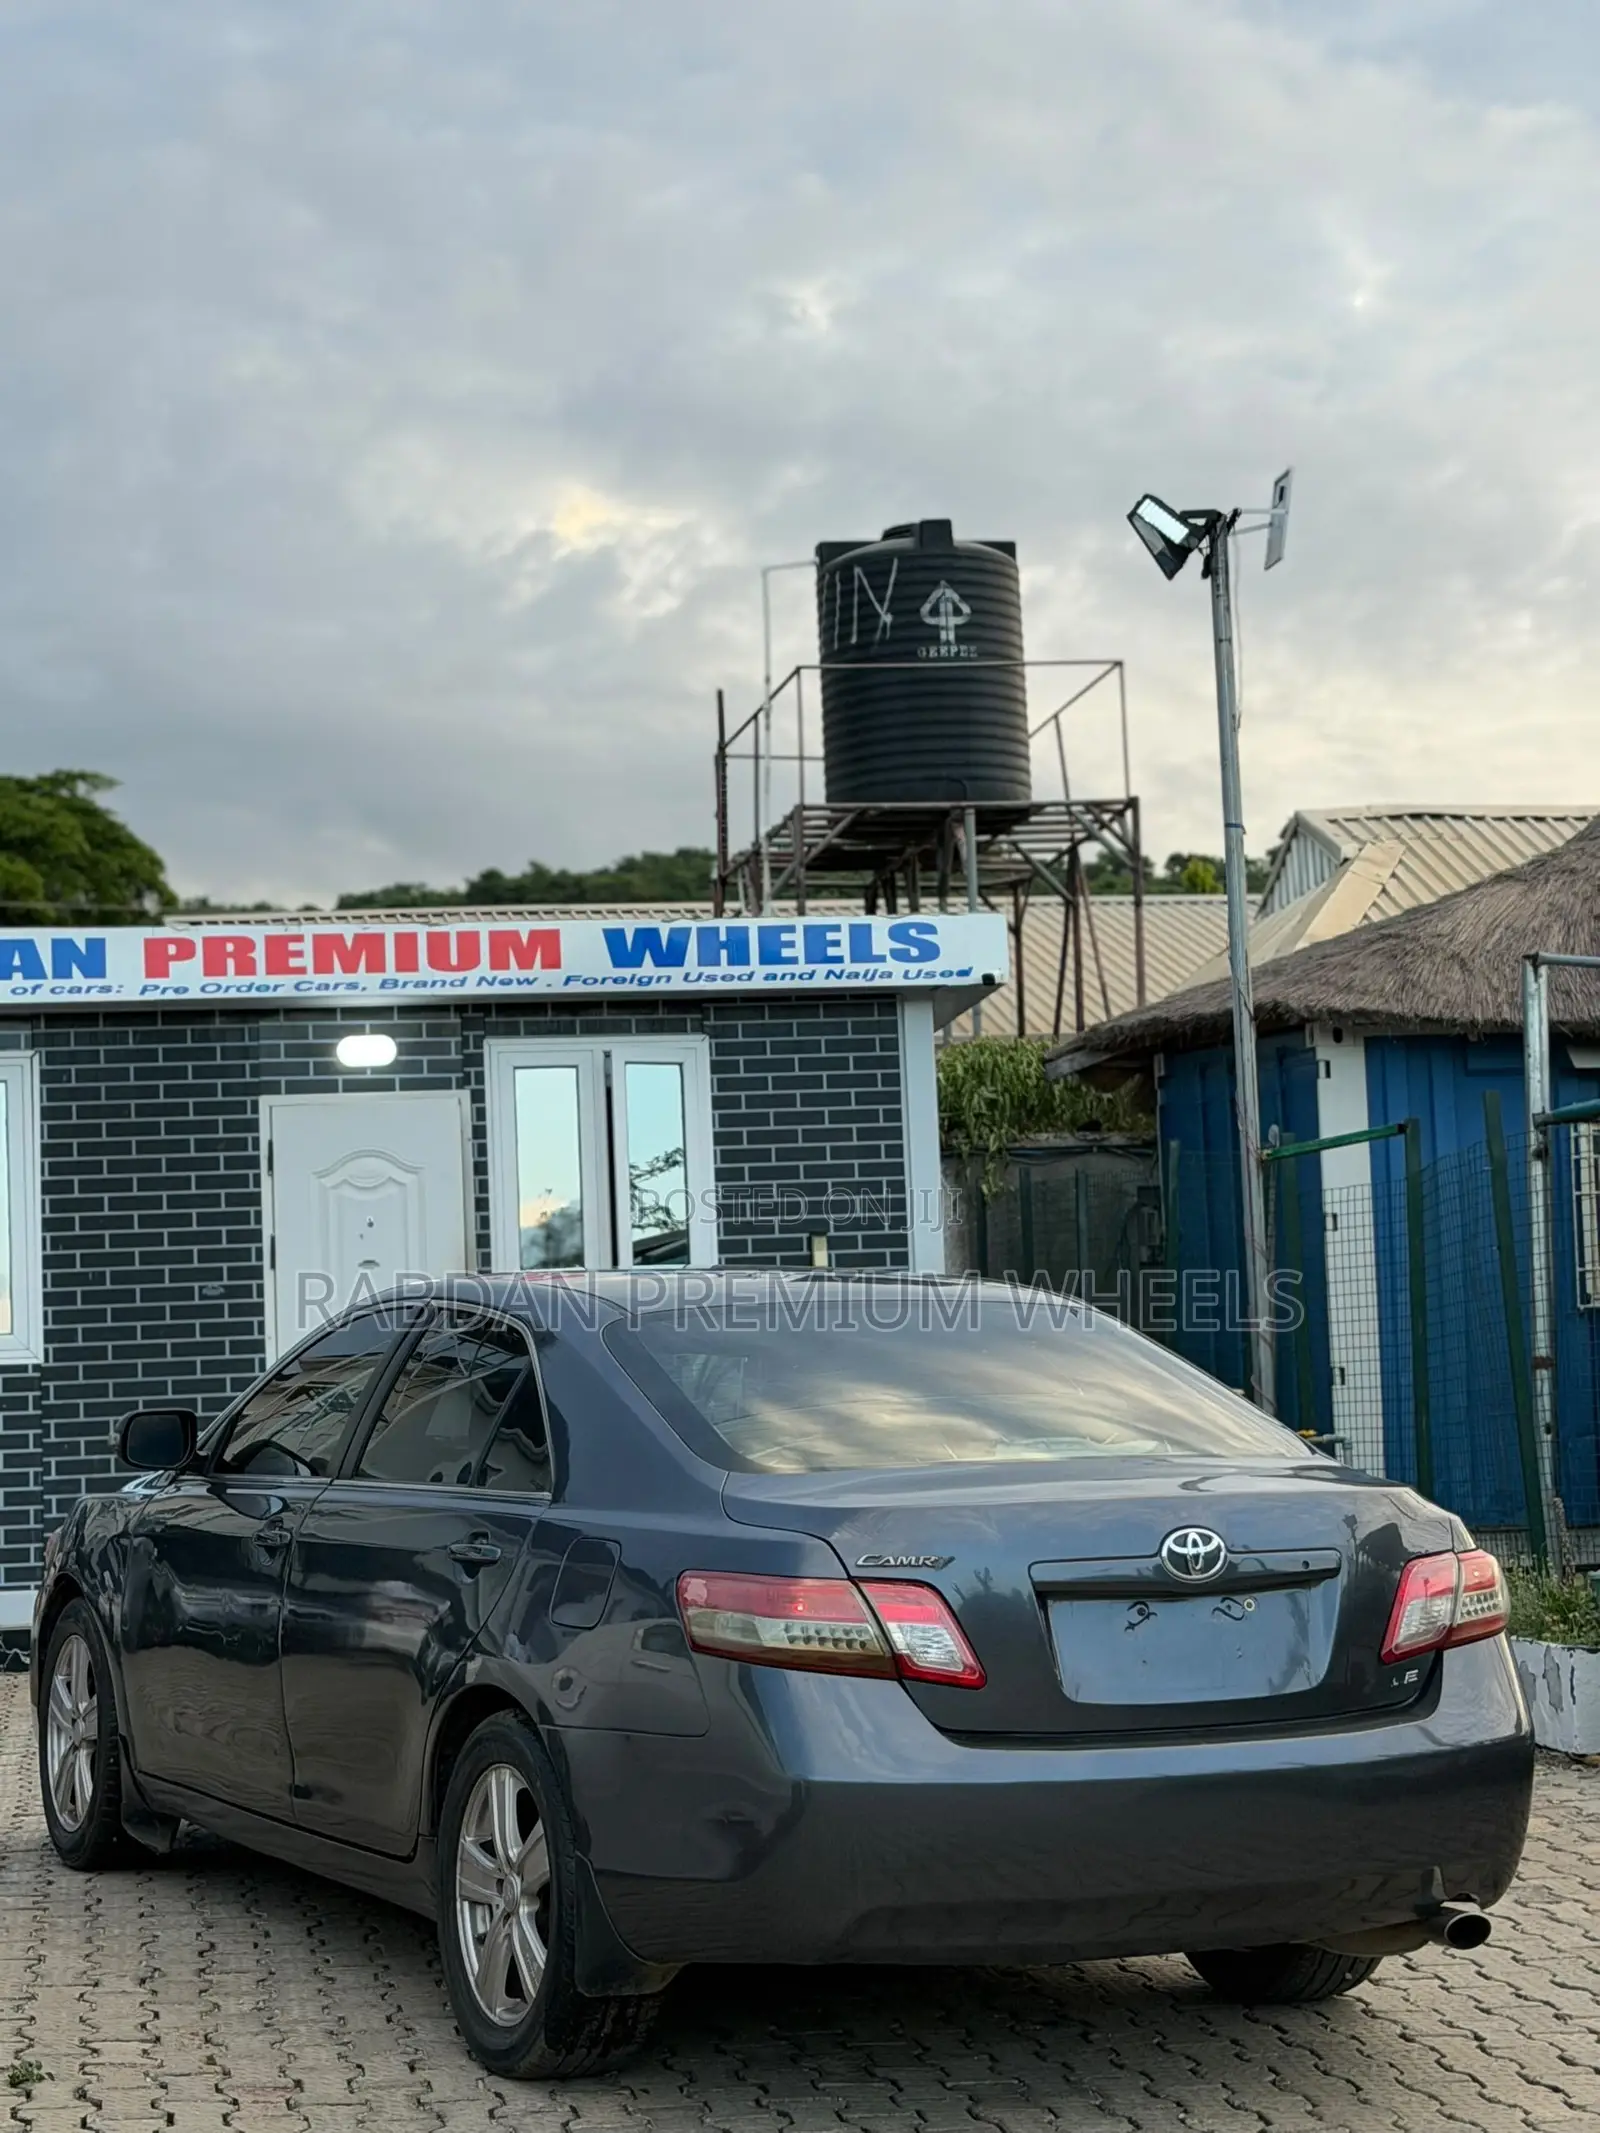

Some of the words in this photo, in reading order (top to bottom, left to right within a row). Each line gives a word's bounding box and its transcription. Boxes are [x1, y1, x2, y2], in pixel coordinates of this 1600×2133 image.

[143, 928, 562, 979] PREMIUM
[602, 921, 941, 968] WHEELS
[10, 983, 44, 996] of
[49, 984, 124, 996] cars:
[139, 983, 190, 996] Pre
[200, 981, 285, 995] Order
[293, 979, 368, 992] Cars,
[378, 975, 467, 991] Brand
[475, 975, 539, 987] New
[562, 973, 672, 987] Foreign
[682, 969, 754, 983] Used
[762, 969, 816, 982] and
[824, 967, 893, 982] Naija
[901, 966, 974, 980] Used
[855, 1553, 957, 1571] CAMRY
